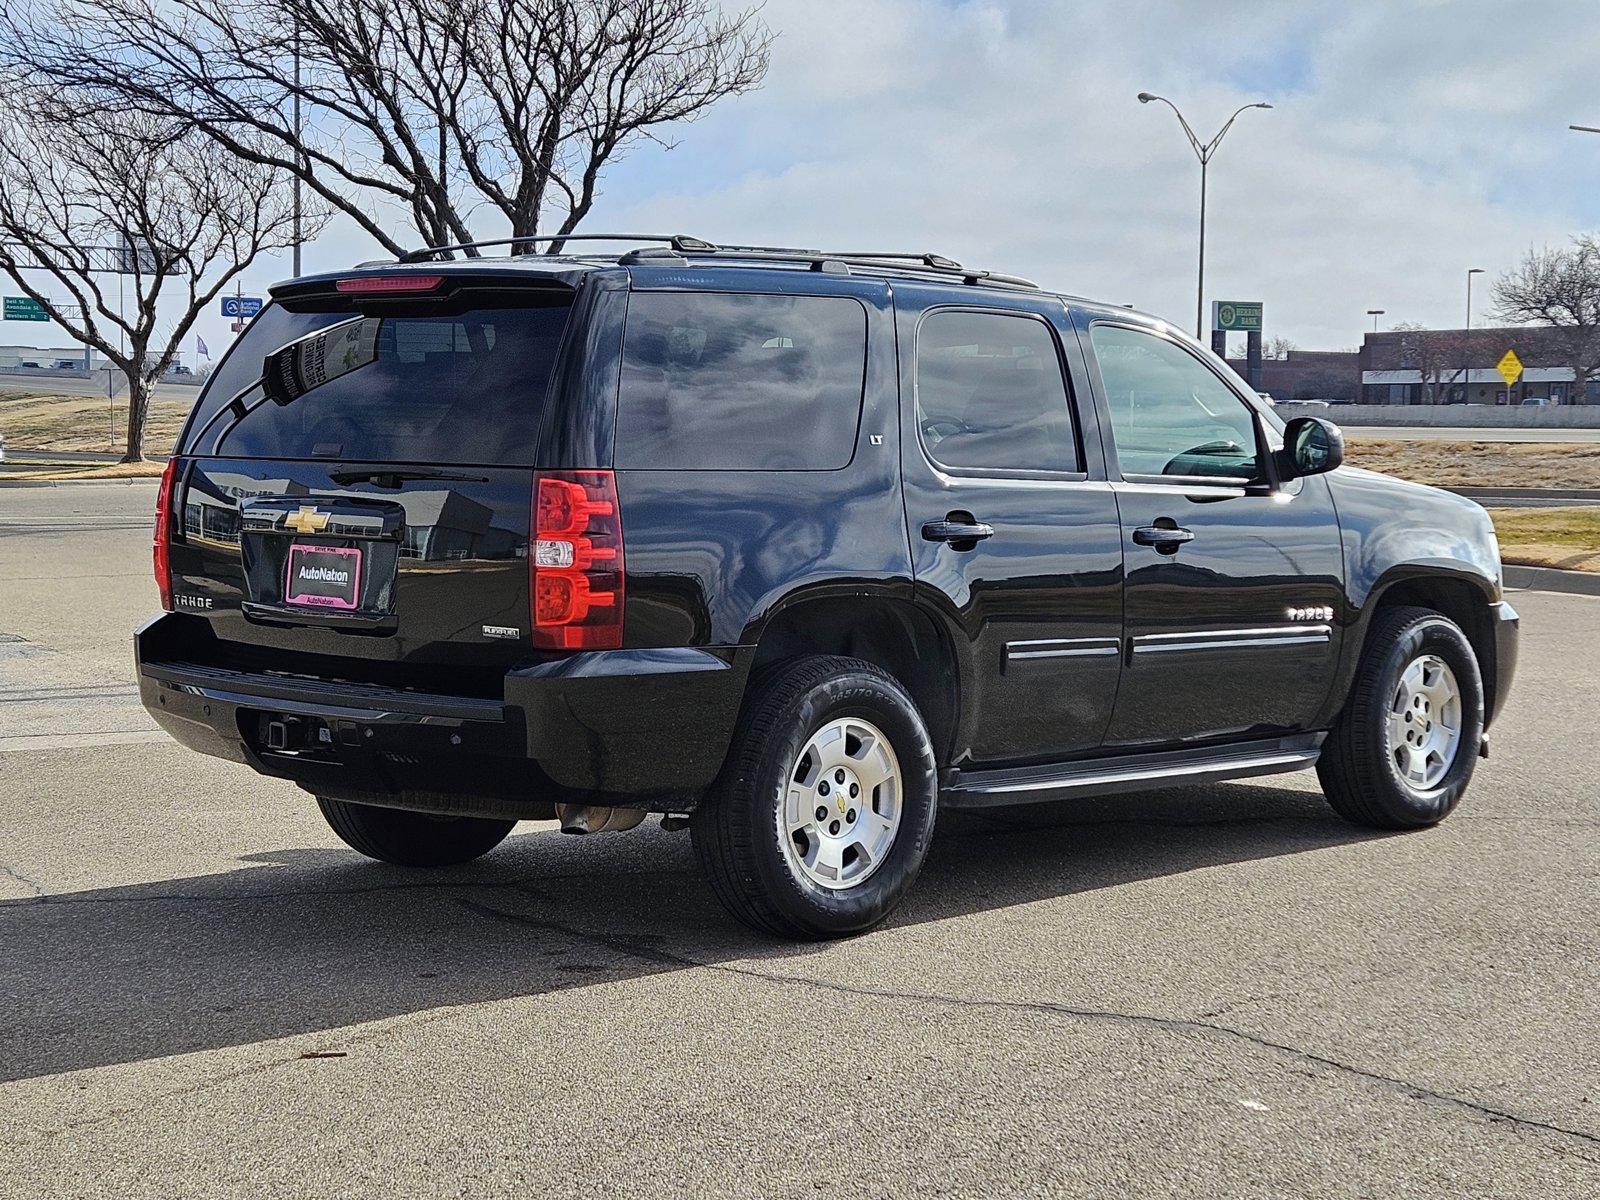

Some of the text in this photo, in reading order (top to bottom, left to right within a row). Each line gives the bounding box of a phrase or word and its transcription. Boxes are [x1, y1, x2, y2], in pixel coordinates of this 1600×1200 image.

[869, 434, 884, 445] LT
[299, 565, 348, 582] AutoNation
[174, 594, 213, 610] TAHOE
[306, 597, 334, 605] AutoNation
